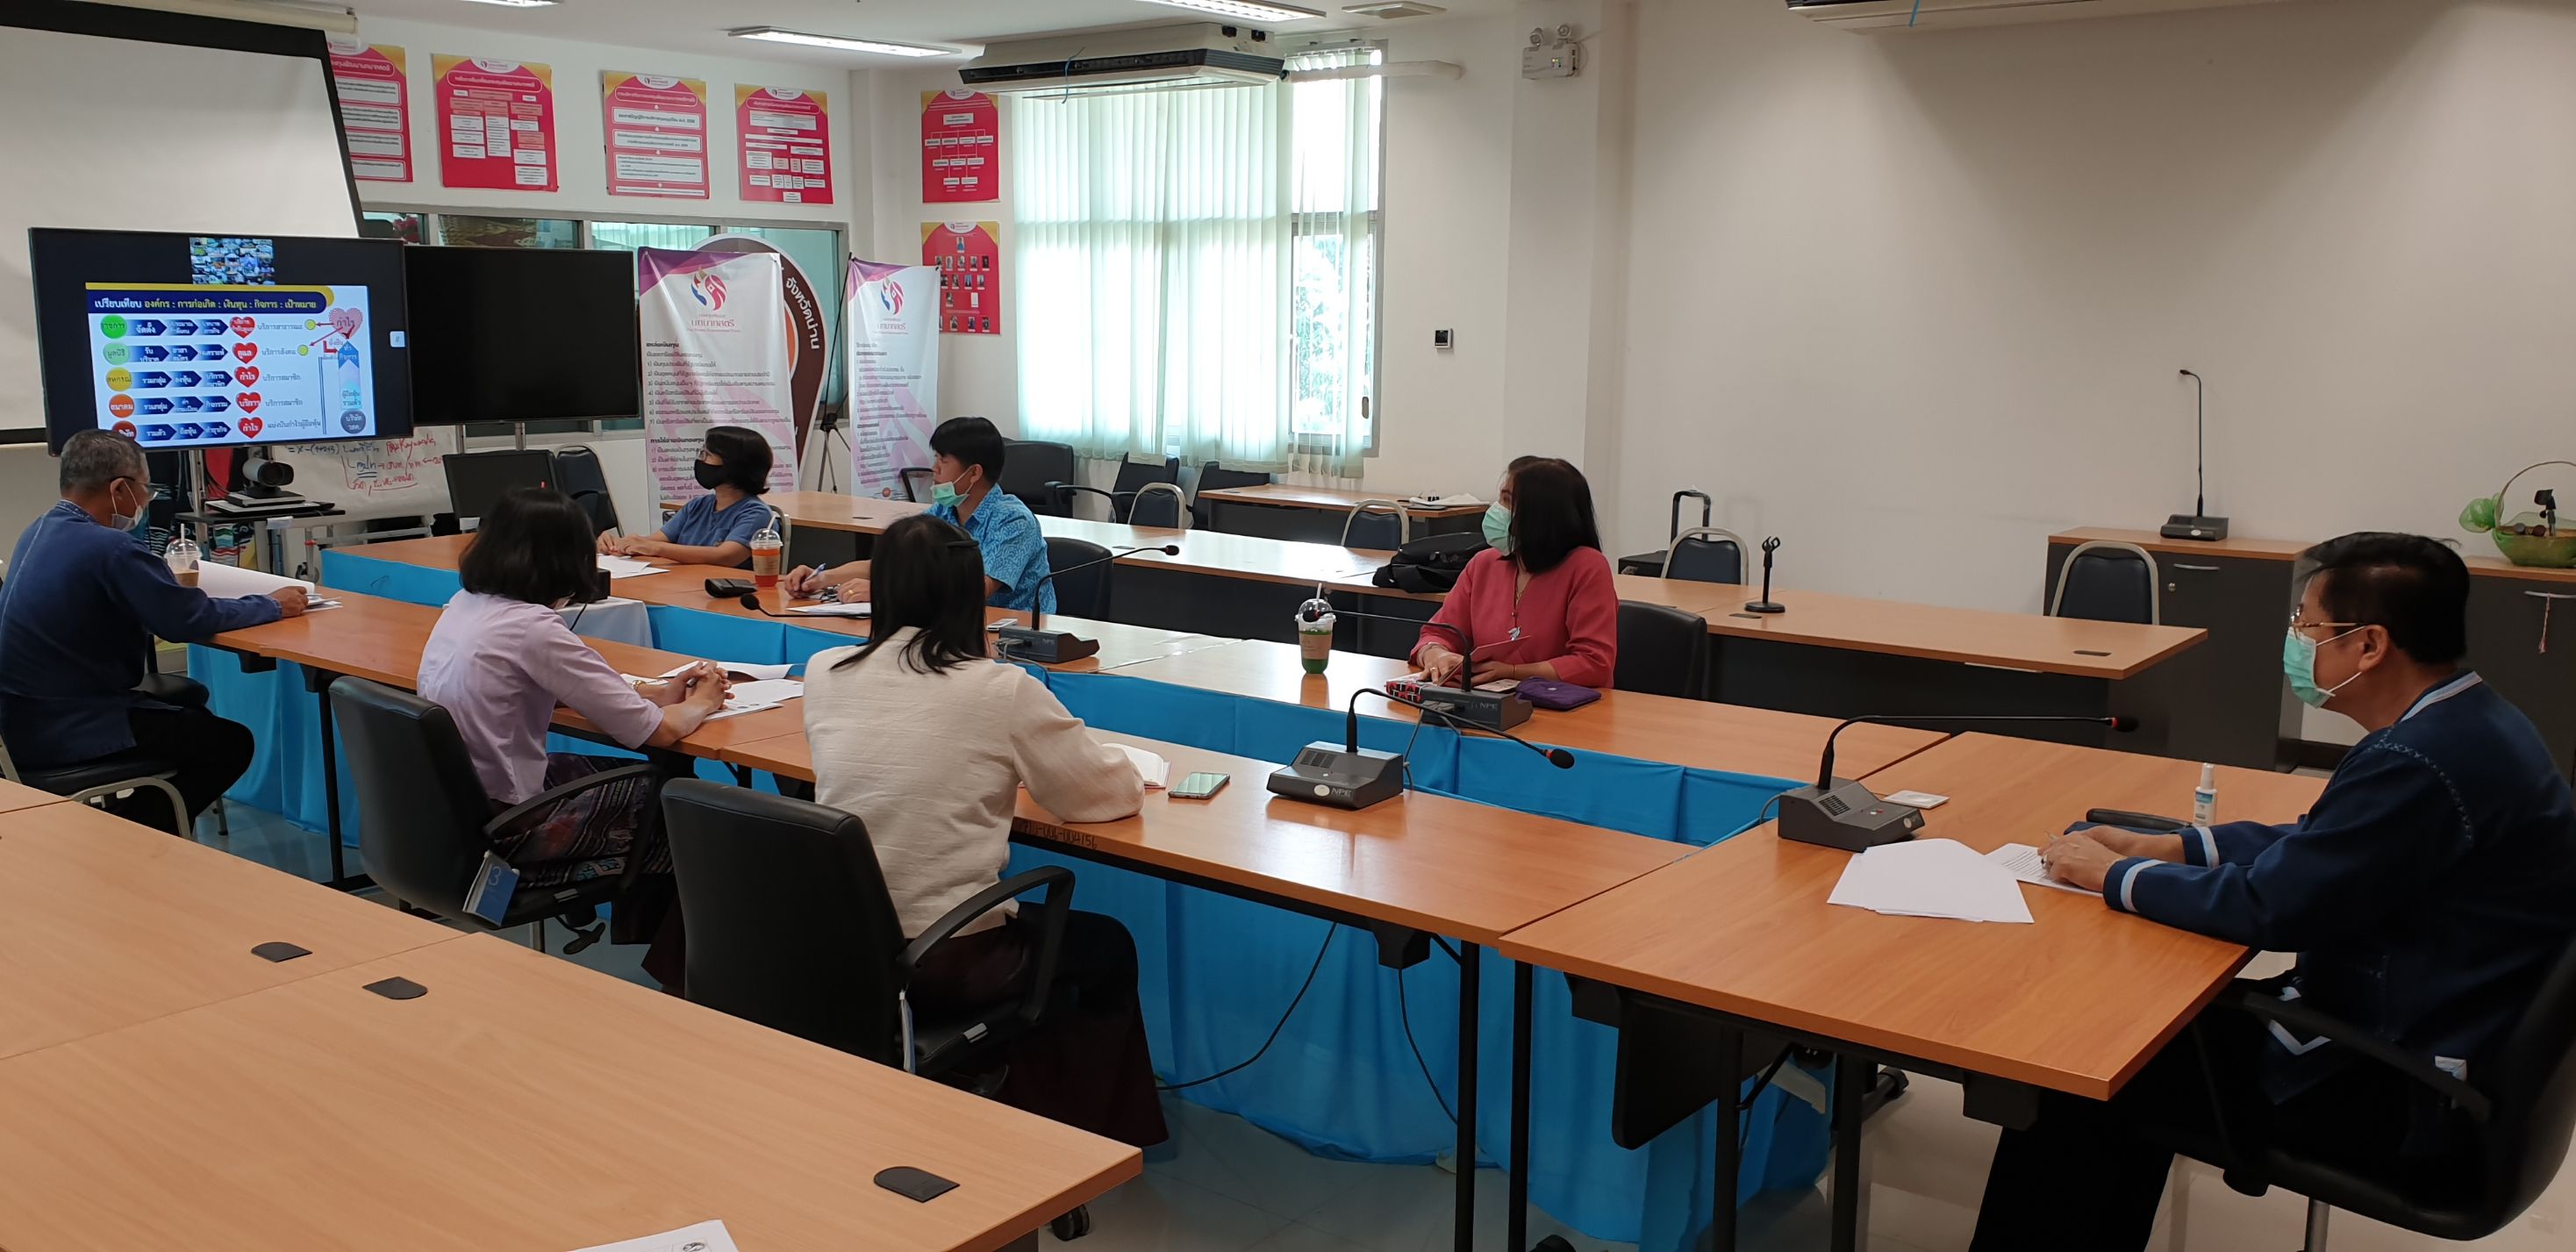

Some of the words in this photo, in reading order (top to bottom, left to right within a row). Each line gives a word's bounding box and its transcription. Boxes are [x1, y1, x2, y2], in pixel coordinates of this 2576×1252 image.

[95, 297, 141, 308] เปรียบเทียบ
[145, 298, 170, 308] องค์กร
[224, 299, 247, 311] เงินทุน
[254, 299, 278, 309] กิจการ
[285, 299, 316, 309] เป้าหมาย
[786, 276, 819, 349] จังหวัดน่าน
[240, 370, 256, 381] กำไร
[242, 422, 259, 432] กำไร
